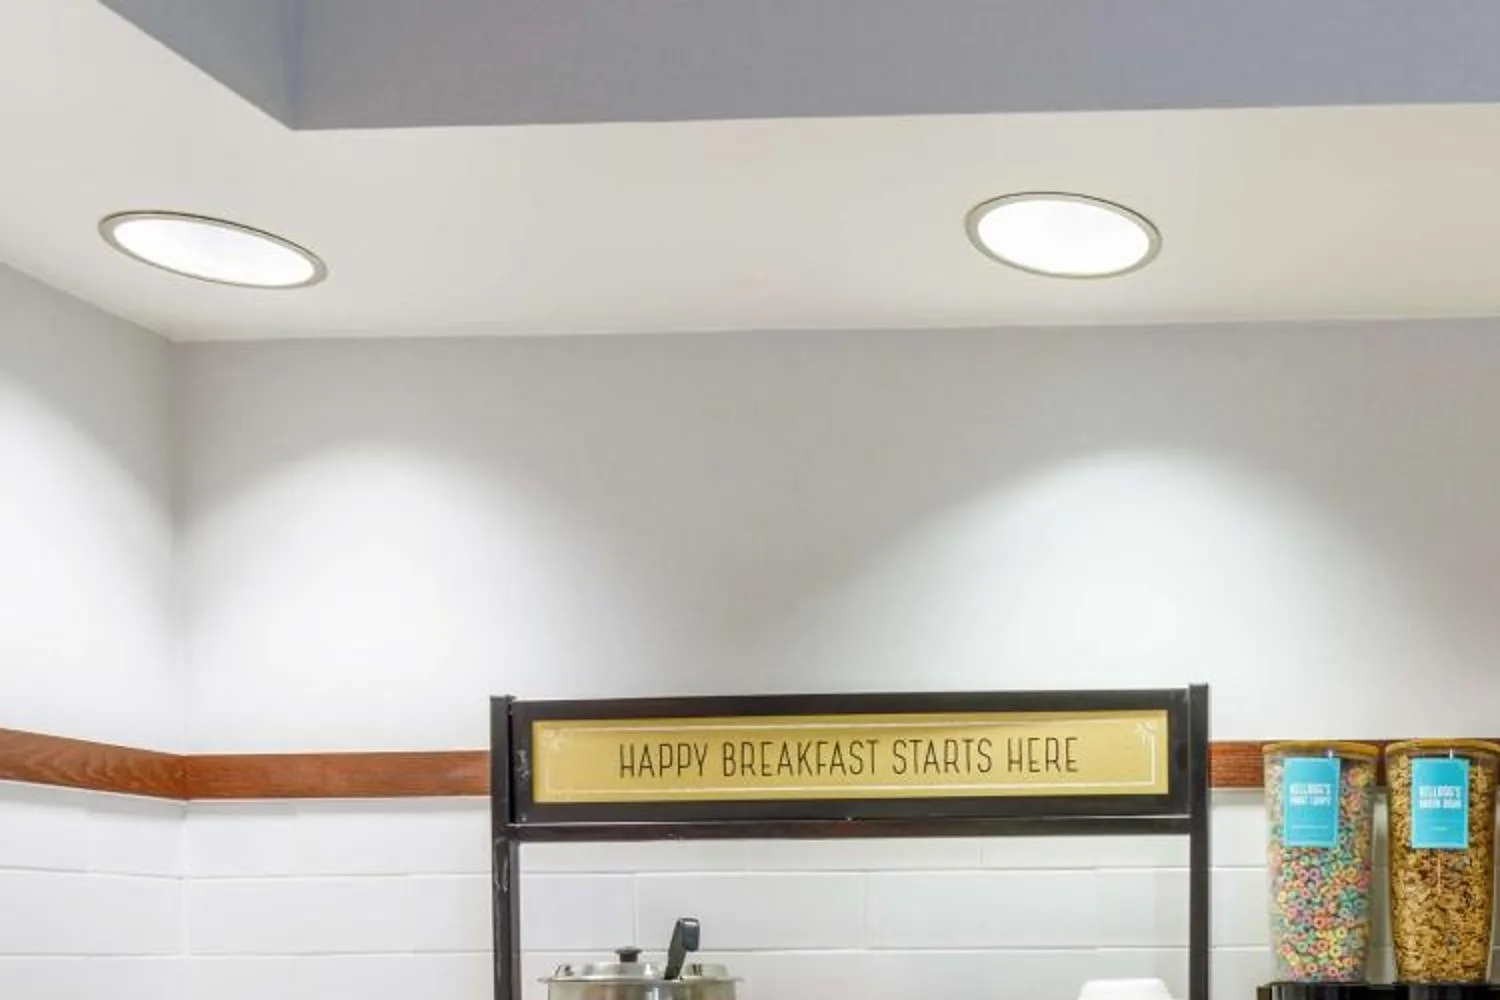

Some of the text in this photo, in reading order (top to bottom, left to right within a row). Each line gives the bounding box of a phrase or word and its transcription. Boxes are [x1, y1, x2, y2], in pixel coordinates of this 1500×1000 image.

[619, 737, 1079, 778] HAPPY BREAKFAST STARTS HERE
